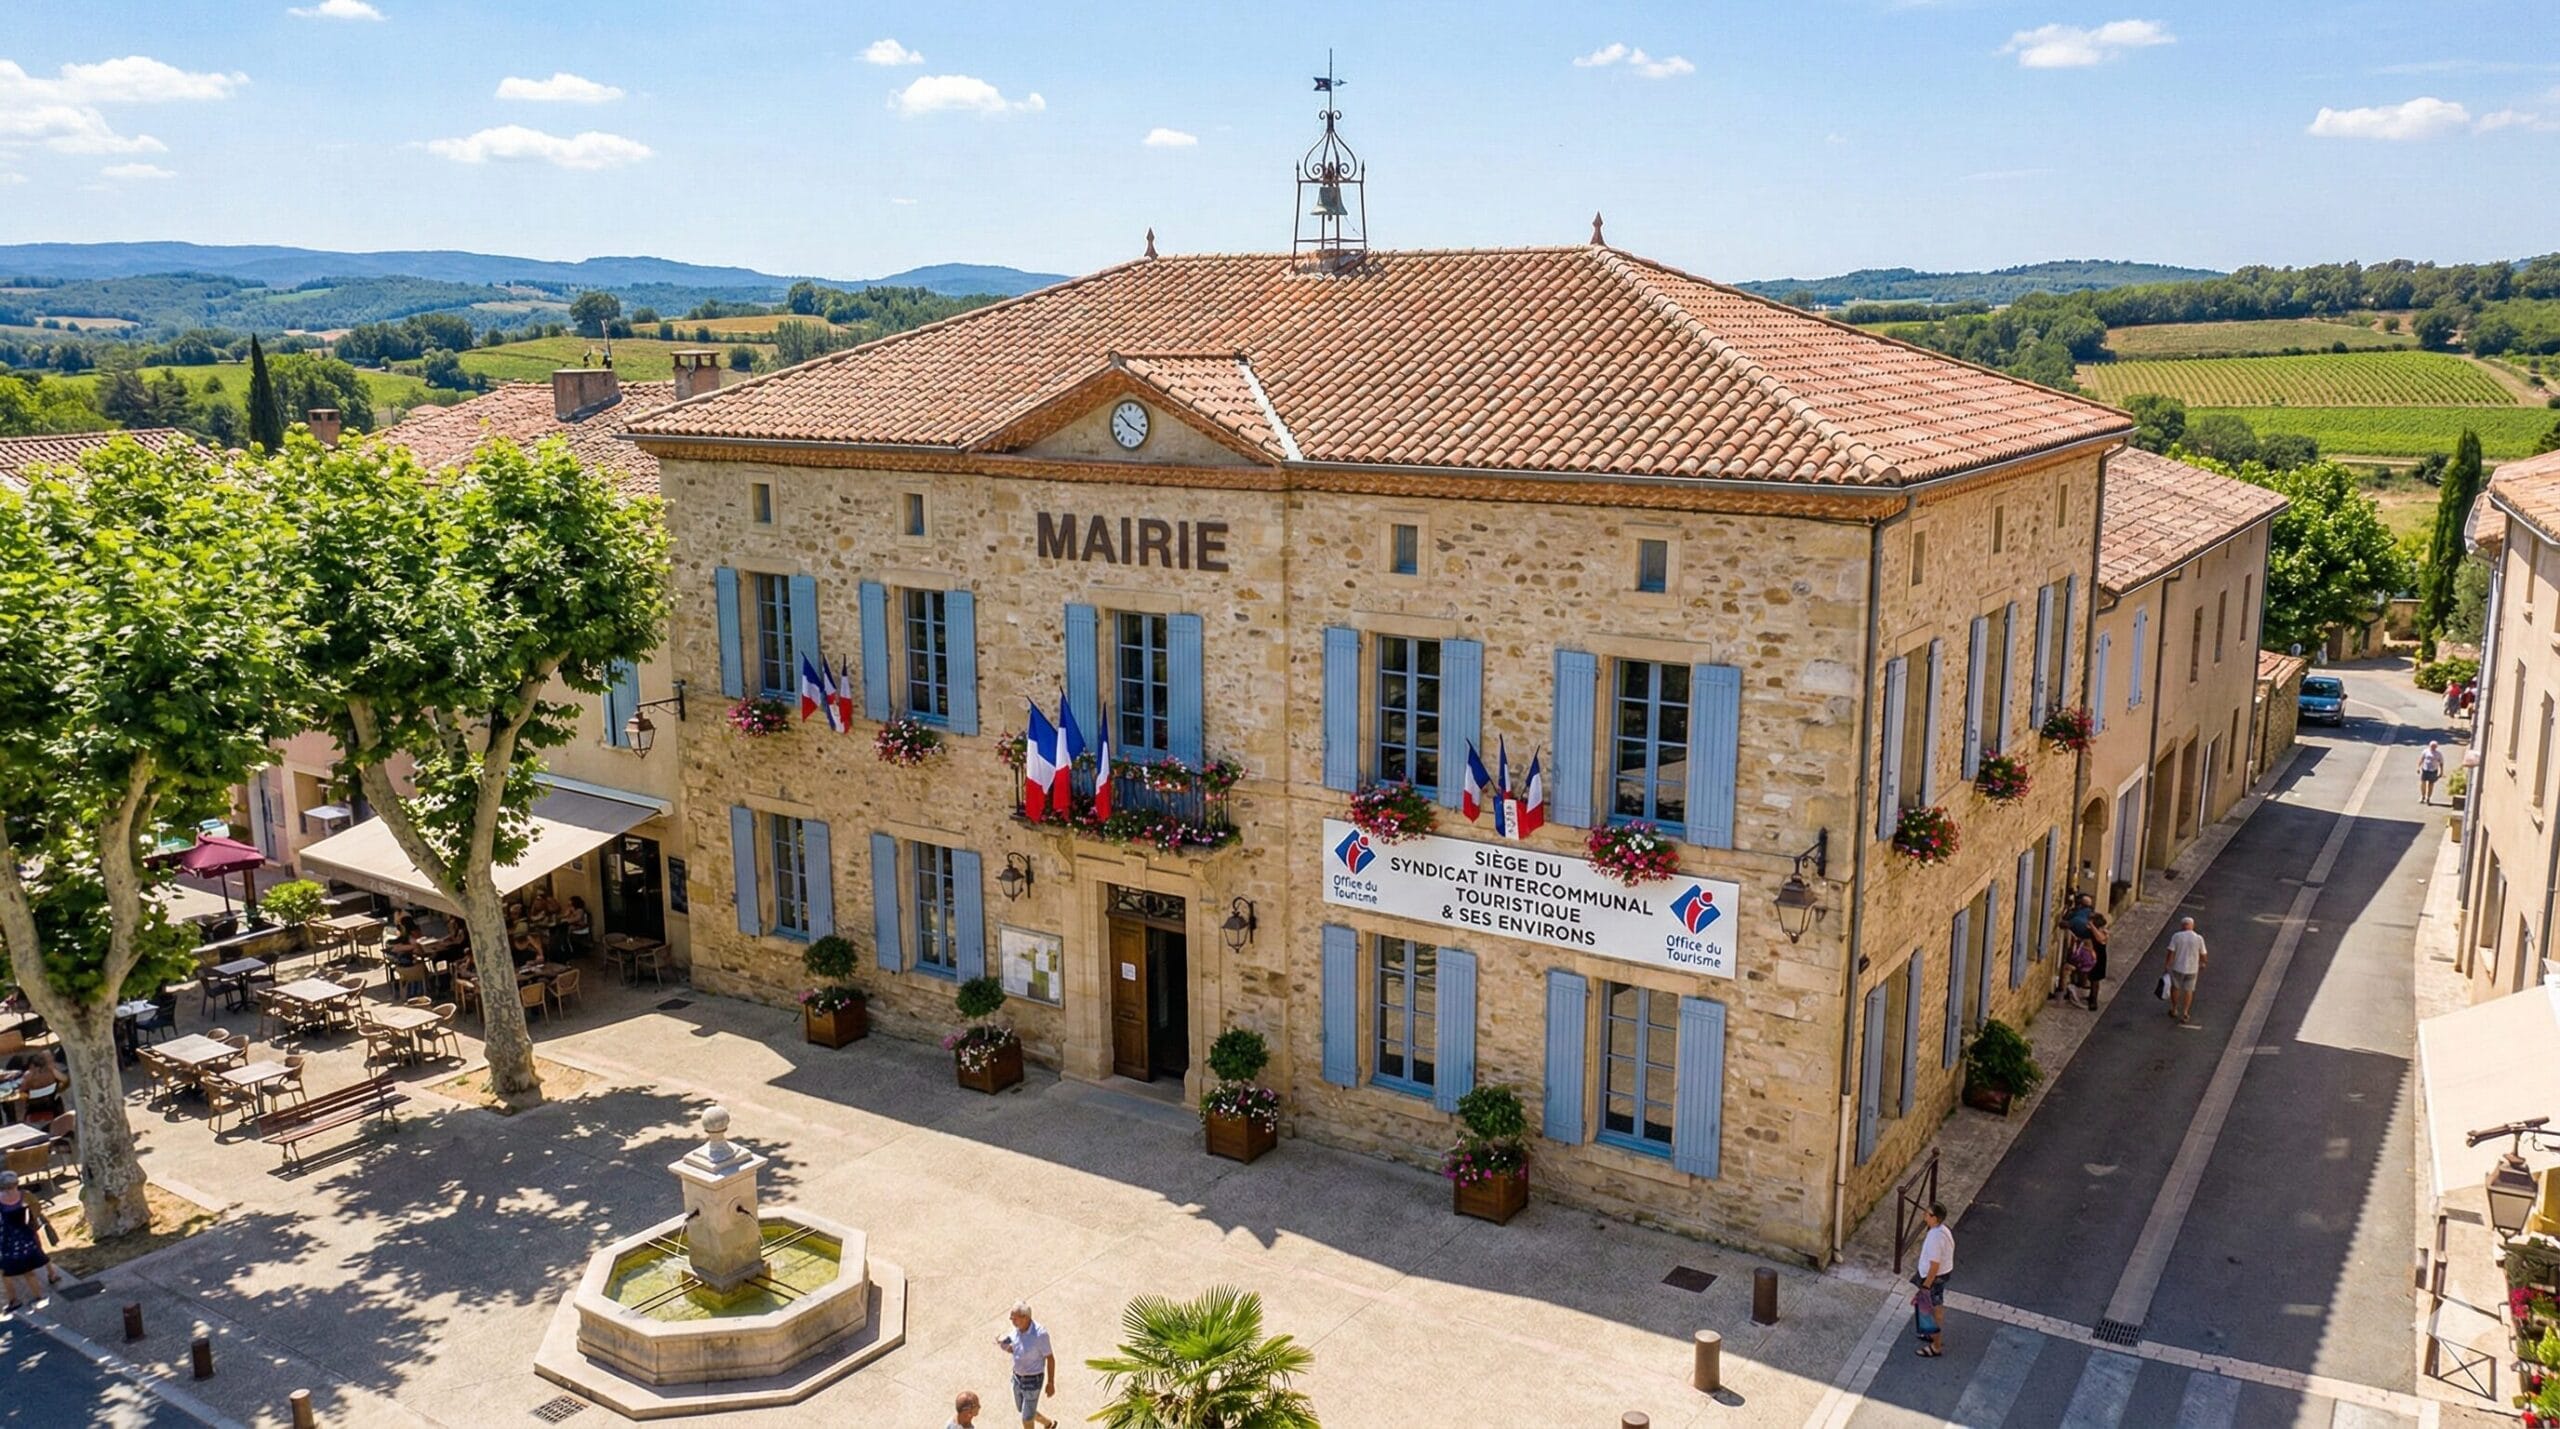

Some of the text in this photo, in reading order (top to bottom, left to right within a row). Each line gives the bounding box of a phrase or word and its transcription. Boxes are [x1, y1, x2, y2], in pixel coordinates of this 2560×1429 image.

[1037, 511, 1230, 572] MAIRIE
[1474, 848, 1562, 879] SIÈGE DU
[1365, 880, 1378, 892] du
[1390, 857, 1654, 916] SYNDICAT INTERCOMMUNAL
[1455, 887, 1581, 924] TOURISTIQUE
[1441, 904, 1596, 946] & SES ENVIRONS
[1666, 934, 1722, 955] Office du
[1666, 947, 1722, 968] Tourisme
